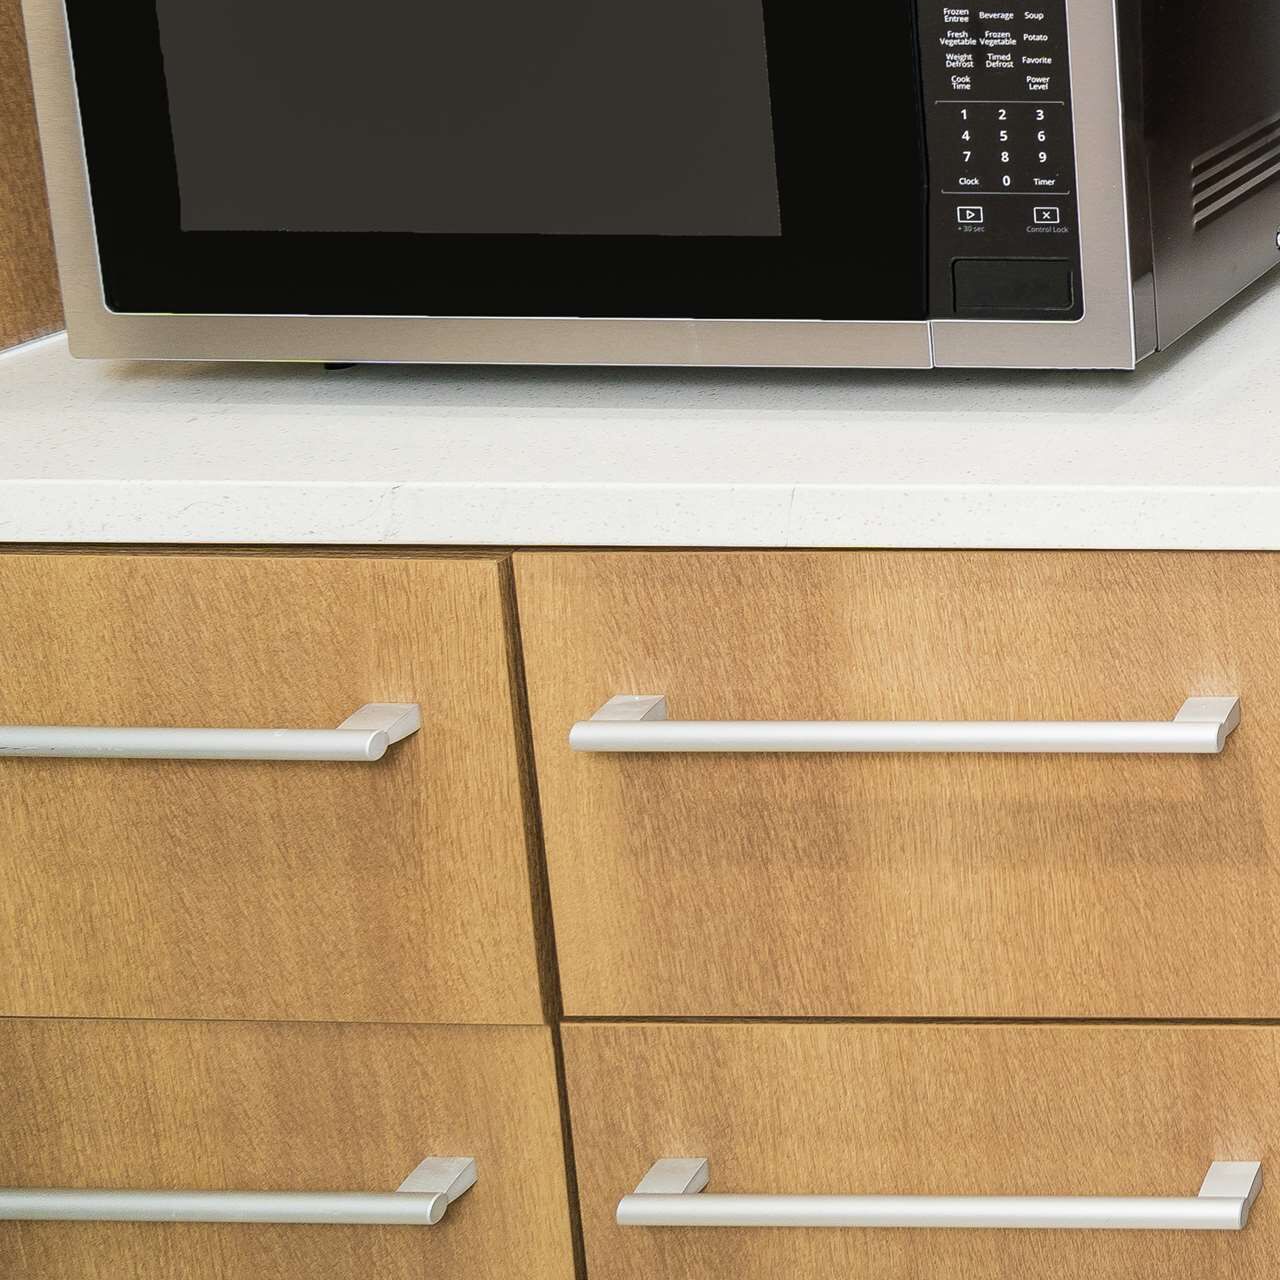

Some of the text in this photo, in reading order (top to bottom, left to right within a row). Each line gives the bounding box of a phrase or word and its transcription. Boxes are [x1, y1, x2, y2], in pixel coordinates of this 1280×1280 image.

[944, 15, 969, 23] Entree
[979, 11, 1014, 21] Beverage
[1024, 11, 1044, 21] Soup
[947, 30, 968, 38] Fresh
[985, 30, 1010, 38] Frozen
[1023, 33, 1048, 41] Potato
[939, 38, 977, 47] Vegetable
[979, 38, 1017, 47] Vegetable
[945, 53, 972, 61] Weight
[987, 53, 1011, 61] Timed
[1022, 56, 1052, 64] Favorite
[951, 75, 971, 83] Cook
[1026, 75, 1050, 83] Power
[952, 82, 971, 90] Time
[960, 109, 967, 120] 1
[998, 109, 1006, 120] 2
[1036, 109, 1044, 120] 3
[961, 130, 970, 141] 4
[999, 130, 1008, 141] 5
[1037, 131, 1046, 142] 6
[963, 151, 971, 162] 7
[1001, 151, 1009, 162] 8
[1038, 152, 1047, 163] 9
[958, 177, 979, 186] Clock
[1002, 176, 1011, 186] 0
[1033, 178, 1055, 186] Timer
[1026, 225, 1069, 233] Control Lock
